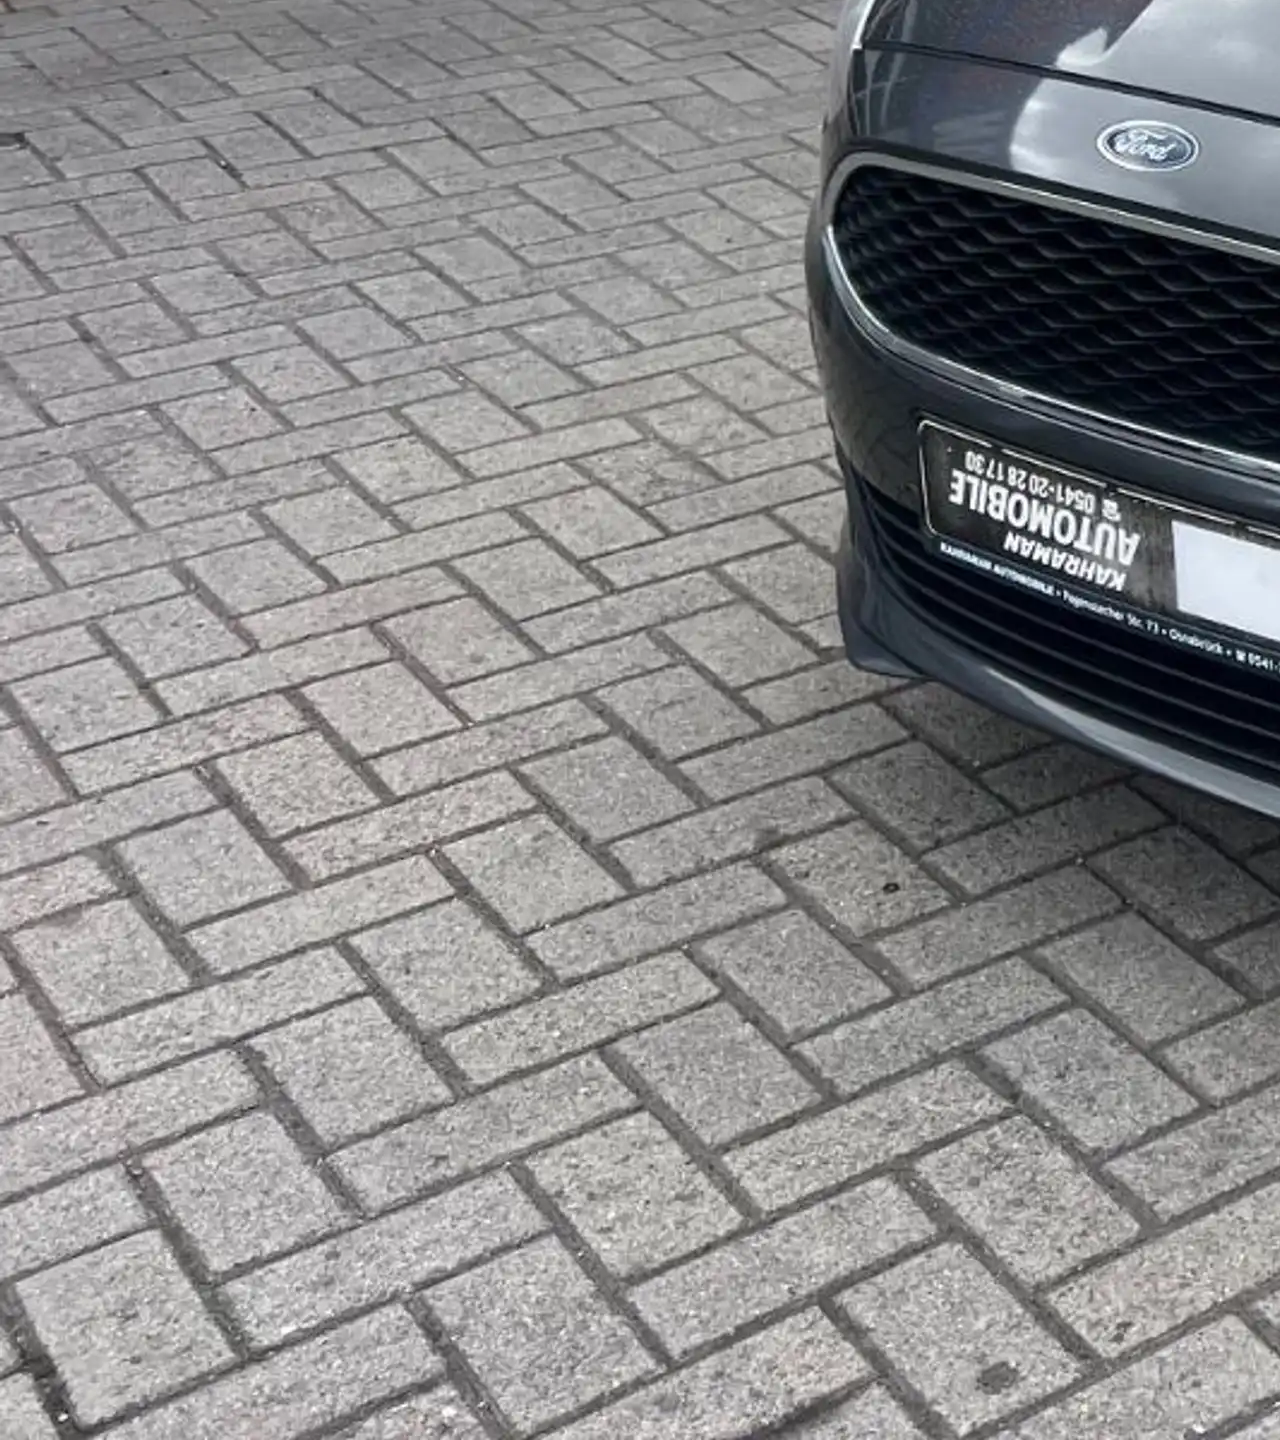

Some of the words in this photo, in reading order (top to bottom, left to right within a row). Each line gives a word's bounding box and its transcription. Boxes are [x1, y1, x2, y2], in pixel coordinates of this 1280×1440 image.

[1113, 128, 1177, 161] Ford
[948, 468, 1141, 566] AUTOMOBILE
[1003, 530, 1128, 592] KAHRAMAN
